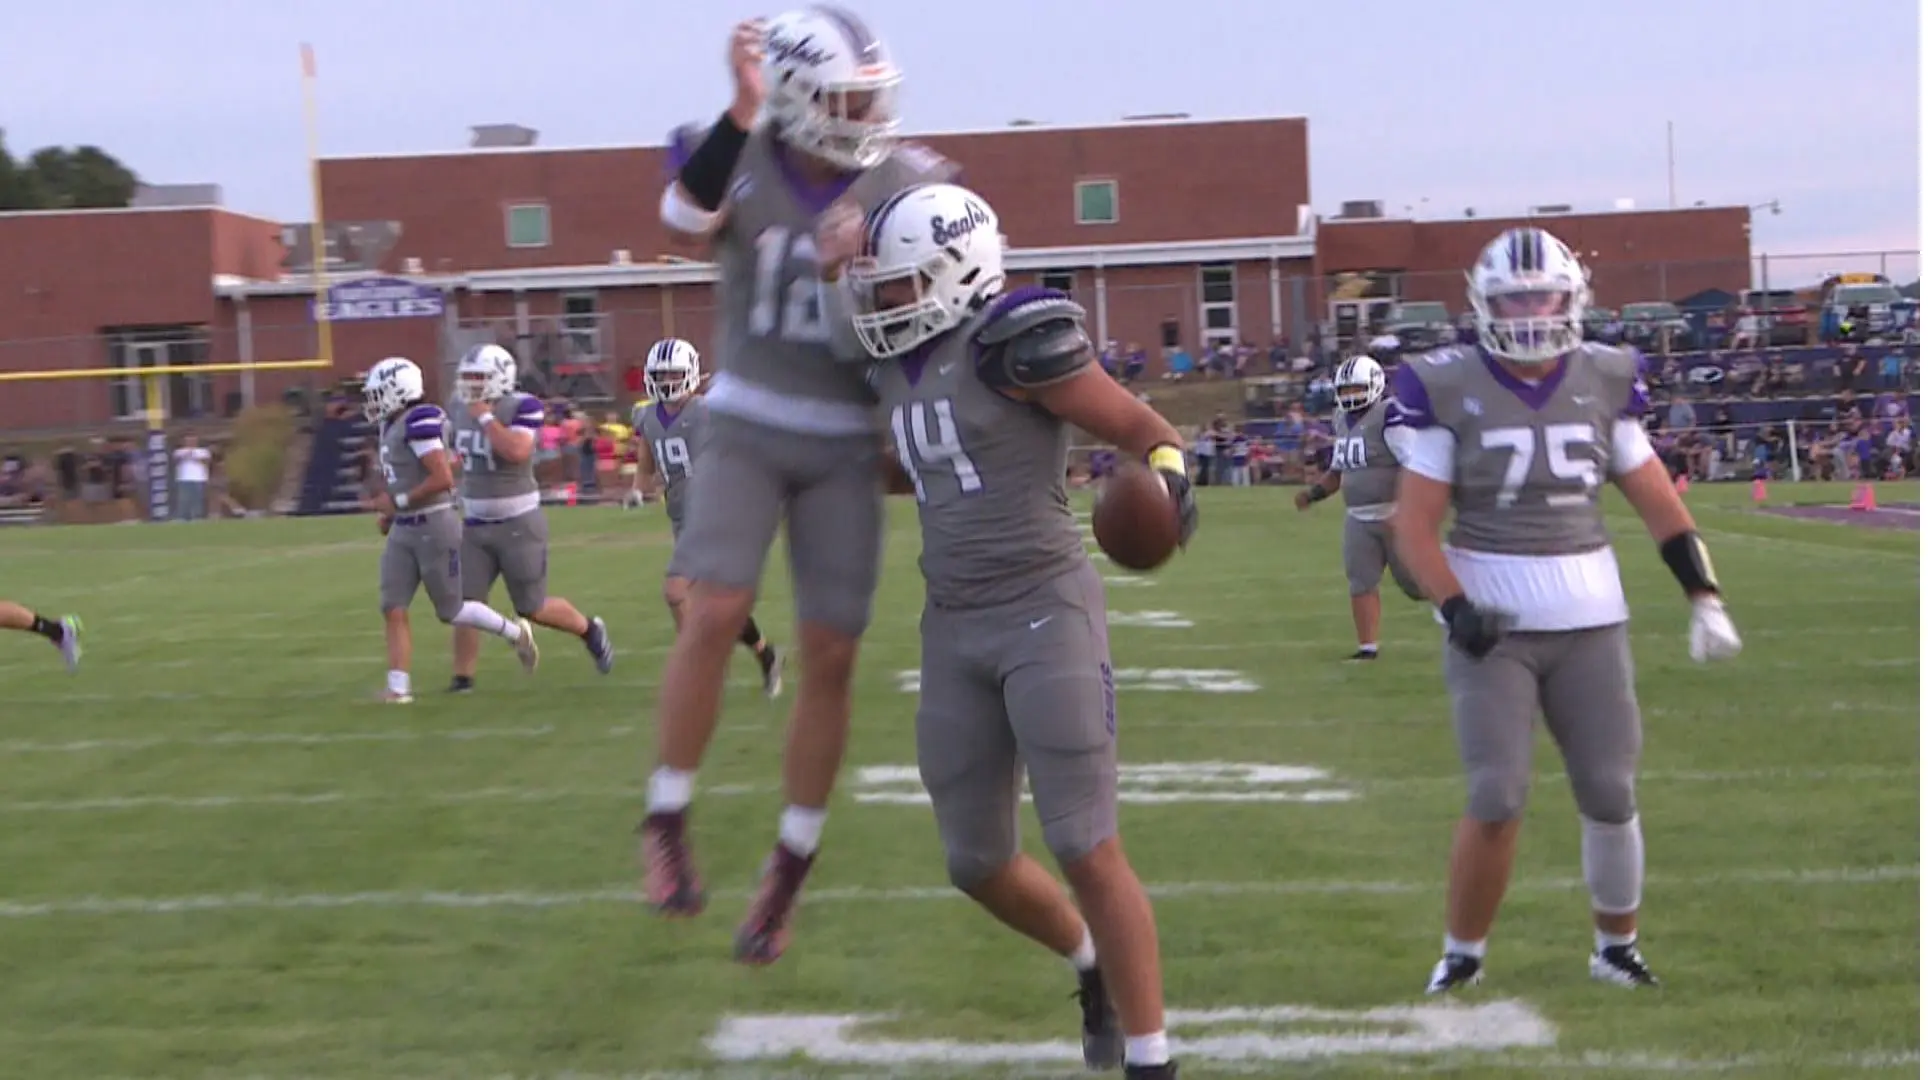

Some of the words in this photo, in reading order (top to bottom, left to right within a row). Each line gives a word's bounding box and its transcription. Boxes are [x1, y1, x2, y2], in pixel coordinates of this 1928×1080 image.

[456, 429, 497, 471] 54
[655, 437, 695, 482] 19
[889, 397, 984, 503] 14
[1480, 422, 1600, 508] 75
